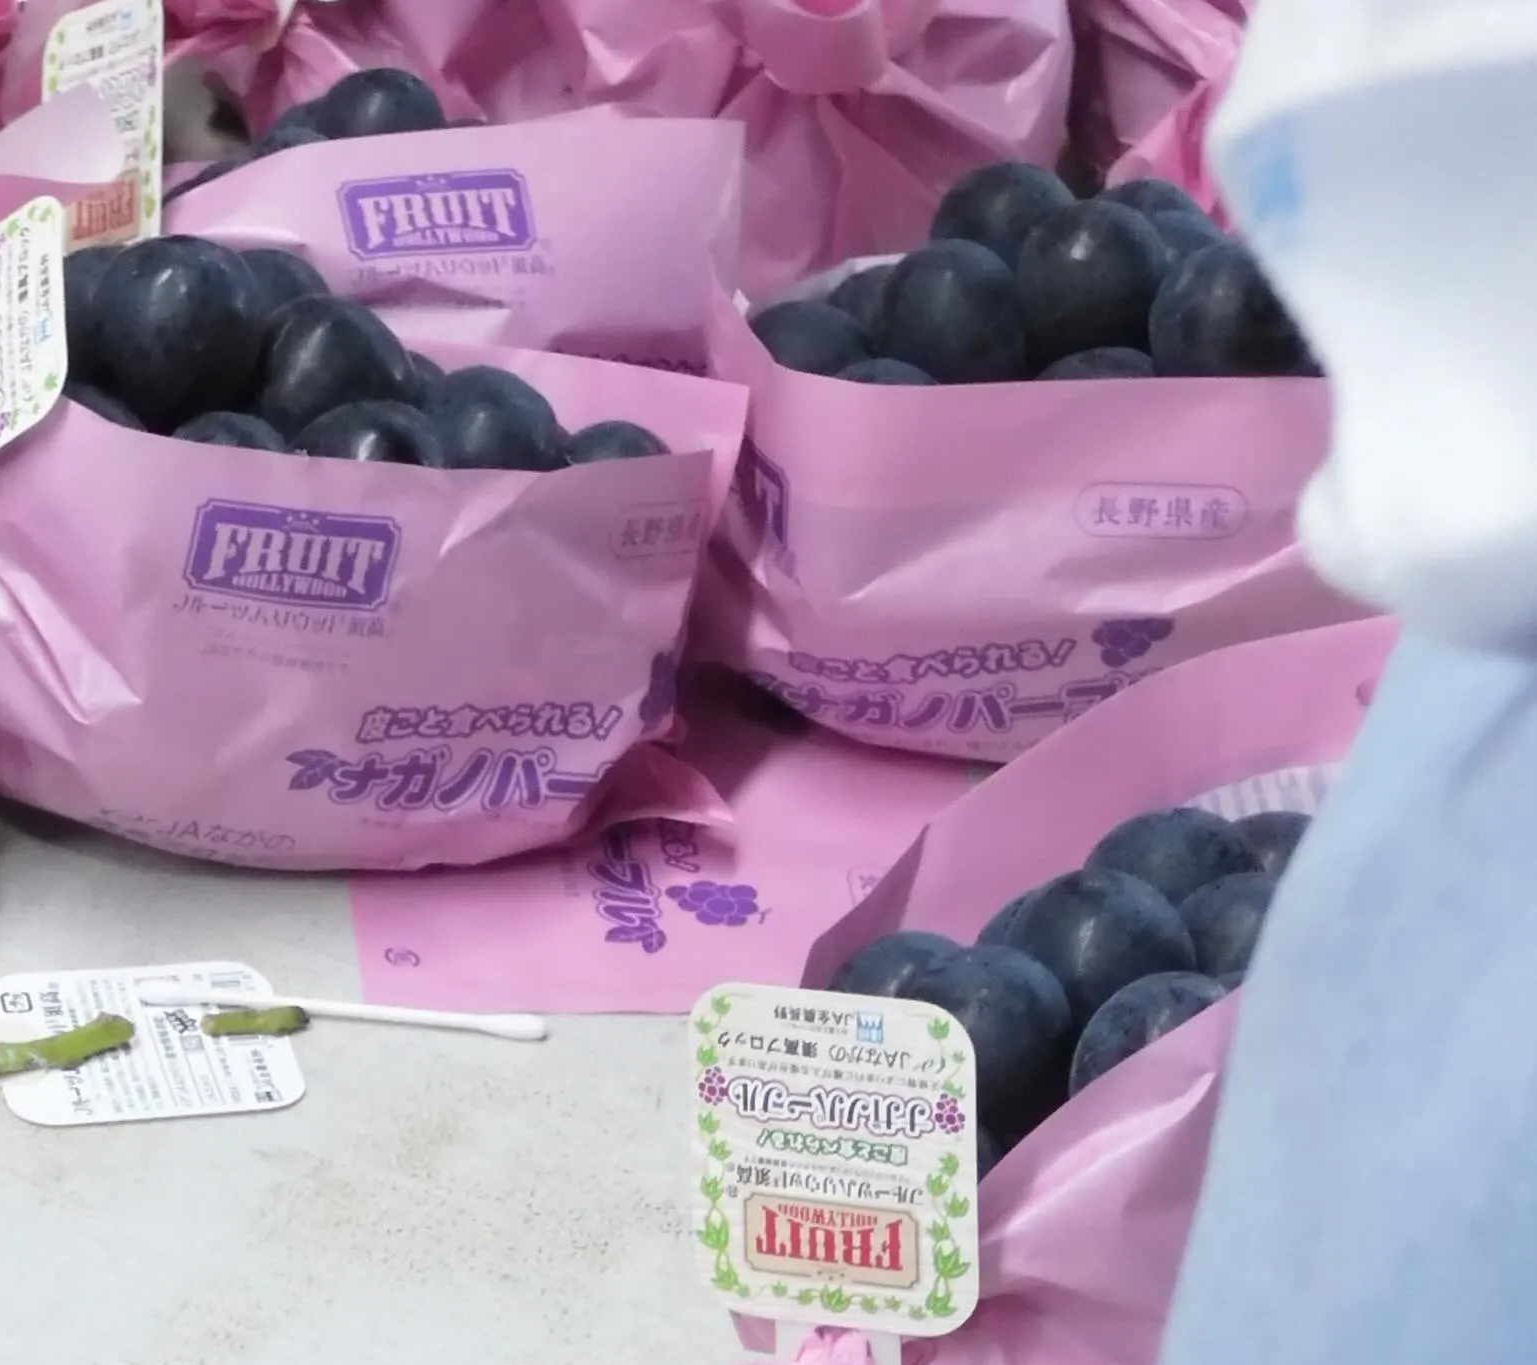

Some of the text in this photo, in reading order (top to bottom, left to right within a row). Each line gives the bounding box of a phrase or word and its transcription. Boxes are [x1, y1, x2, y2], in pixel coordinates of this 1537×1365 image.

[357, 187, 517, 250] FRUIT
[1092, 496, 1231, 530] 長野県産
[204, 522, 384, 596] FRUIT
[774, 1004, 855, 1027] JA全農長野
[717, 1031, 913, 1071] JAながの 須高ブロック
[727, 1076, 935, 1139] ナガノパープル
[735, 1164, 923, 1204] フルーツハリウッド須高
[777, 1203, 879, 1229] HOLLYWOOD
[755, 1205, 904, 1272] FRUIT
